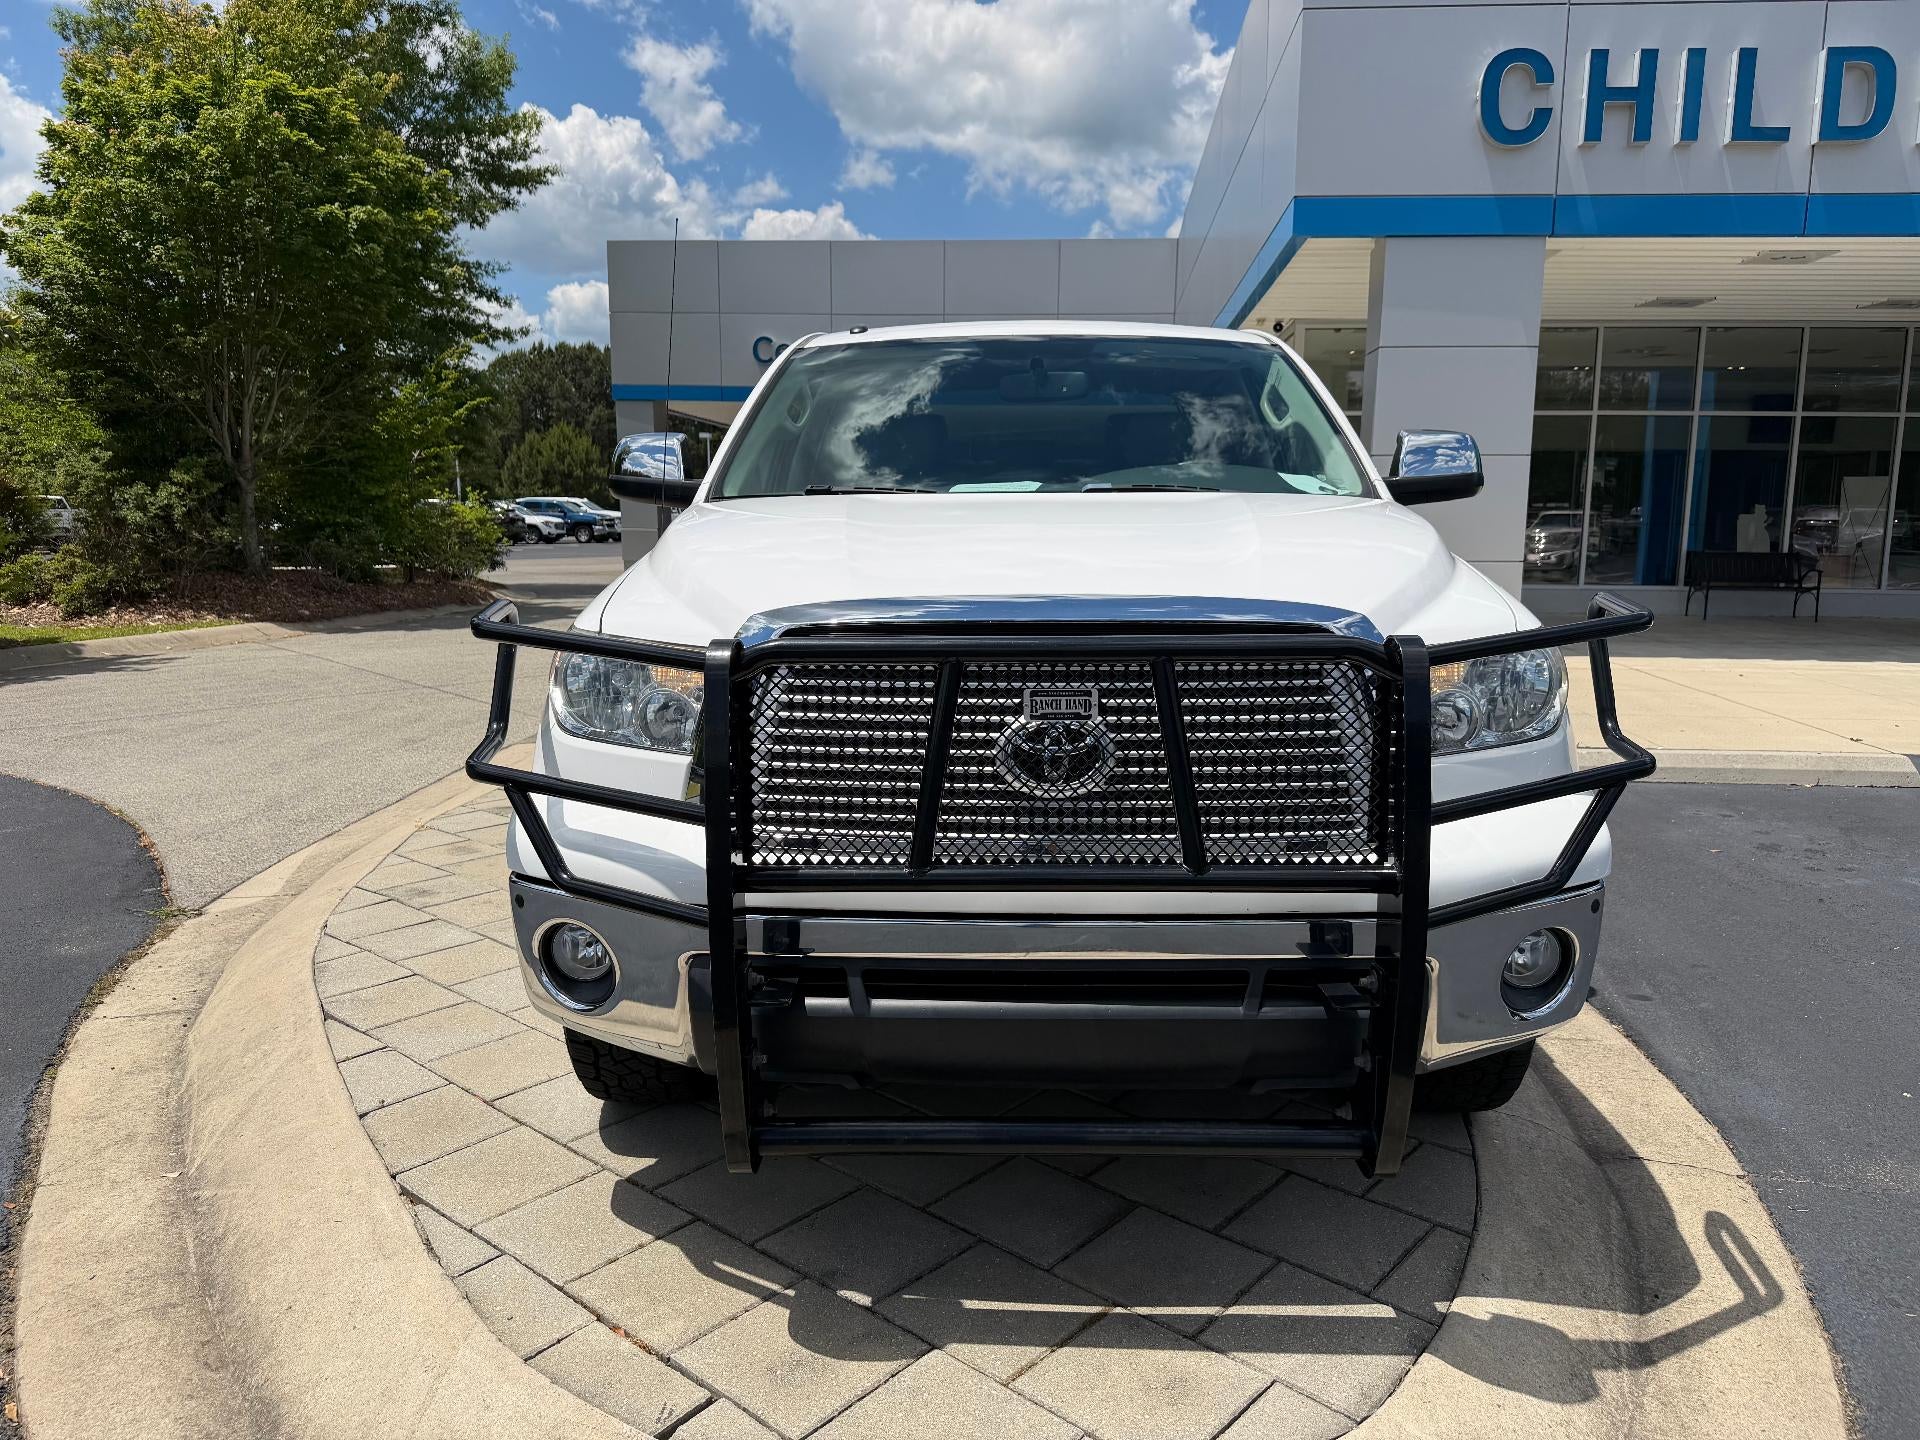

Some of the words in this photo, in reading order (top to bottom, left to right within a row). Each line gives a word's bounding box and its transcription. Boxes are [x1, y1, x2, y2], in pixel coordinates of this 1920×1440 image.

[1477, 46, 1920, 146] CHILD
[1030, 699, 1062, 713] RANCH
[1065, 699, 1093, 713] HAND
